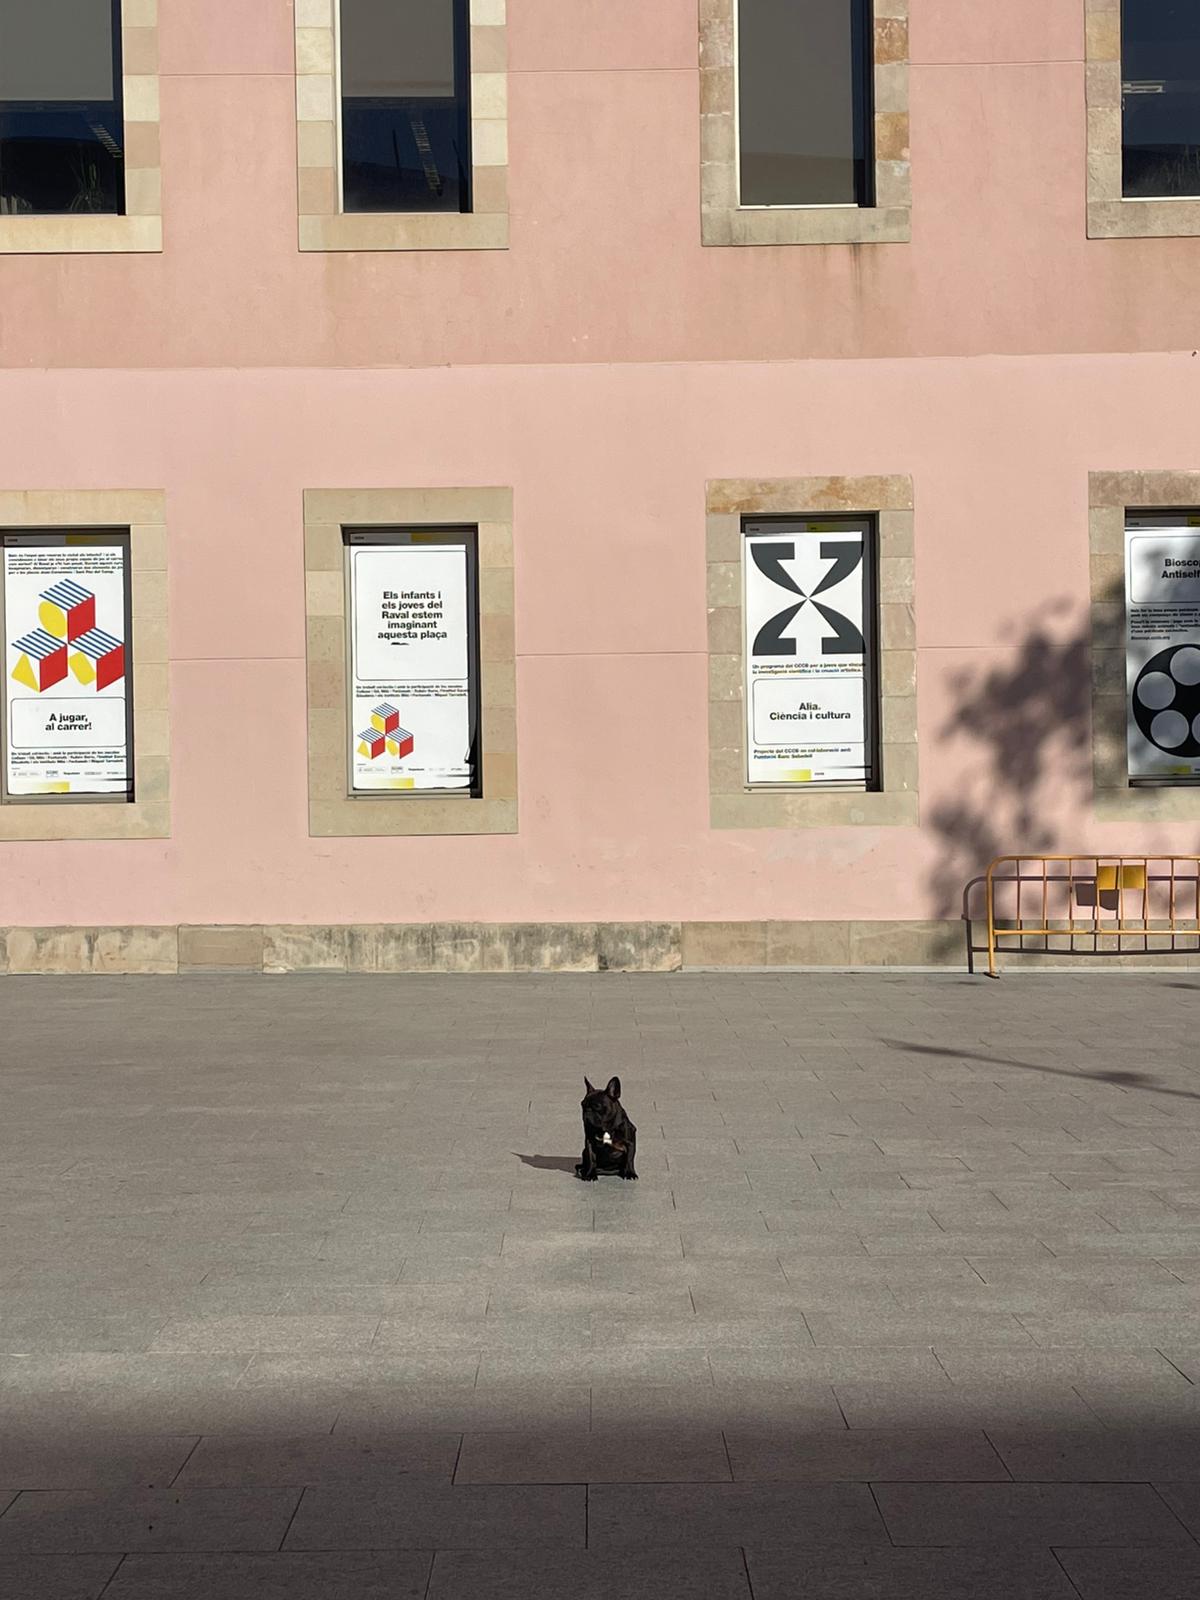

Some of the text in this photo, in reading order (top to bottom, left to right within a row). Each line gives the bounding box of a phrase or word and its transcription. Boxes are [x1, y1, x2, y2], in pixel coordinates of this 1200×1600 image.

[383, 591, 441, 600] Els infants i
[382, 600, 443, 611] els joves del
[382, 611, 443, 619] Raval estem
[387, 621, 437, 630] imaginant
[377, 630, 447, 640] aquesta plaça
[799, 702, 821, 711] Alia.
[49, 713, 88, 723] A jugar,
[809, 711, 813, 720] i
[815, 711, 851, 720] cultura
[45, 722, 92, 731] al carrer!
